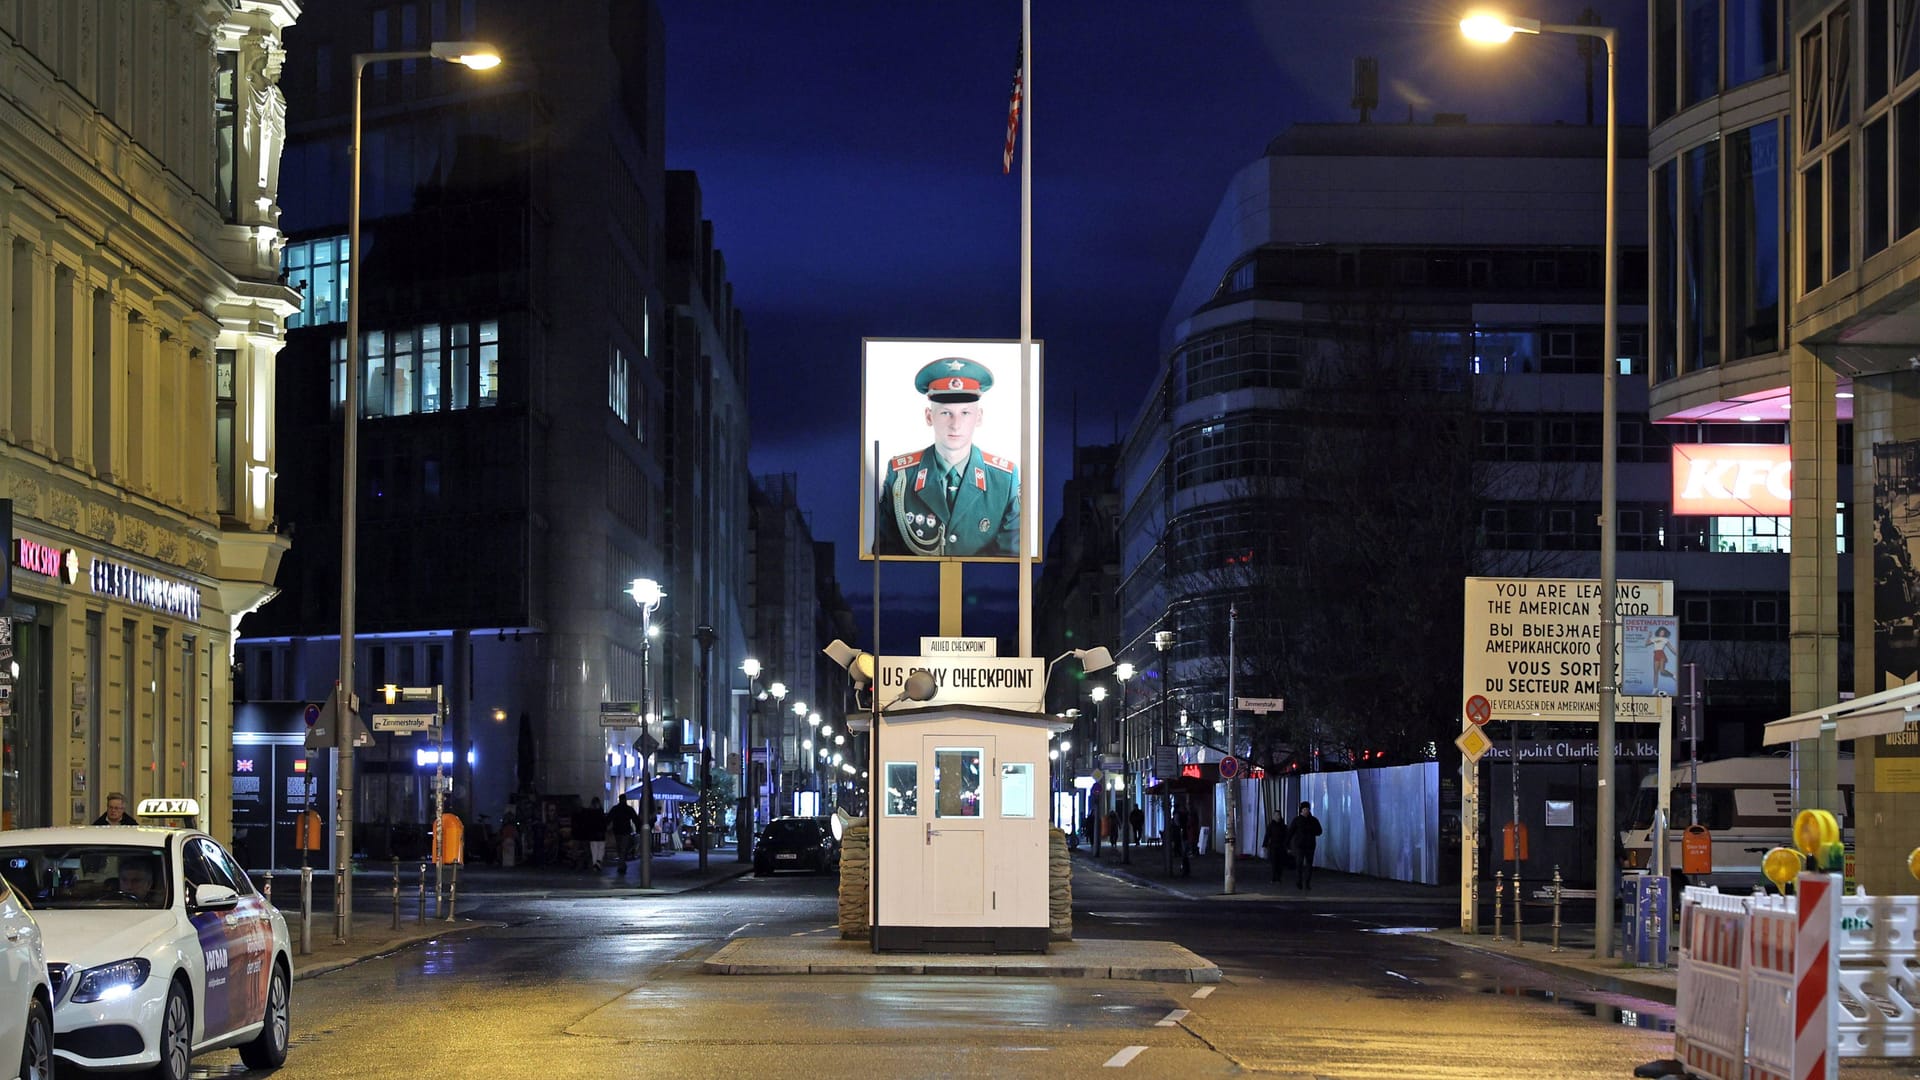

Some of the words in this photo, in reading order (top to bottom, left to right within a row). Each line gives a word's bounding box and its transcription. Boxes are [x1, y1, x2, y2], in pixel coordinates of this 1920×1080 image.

[1681, 459, 1791, 499] KFC
[21, 538, 41, 572] ROCK
[41, 545, 61, 577] SHOP
[1496, 583, 1527, 597] YOU
[1536, 584, 1566, 598] ARE
[1577, 585, 1640, 599] LEAING
[1488, 601, 1511, 614] THE
[1519, 601, 1589, 615] AMERICAN
[1599, 602, 1649, 616] CTOR
[1490, 623, 1512, 637] ВЫ
[1523, 624, 1600, 638] ВЫЕЗЖАЕ
[931, 641, 950, 652] ALLIED
[951, 641, 987, 652] CHECKPOINT
[1486, 640, 1590, 655] АМЕРИКАНСКОГО
[1508, 661, 1551, 675] VOUS
[1560, 661, 1619, 677] SORTZ
[953, 668, 1034, 688] CHECKPOINT
[1486, 678, 1503, 692] DU
[1509, 679, 1569, 693] SECTEUR
[1498, 700, 1539, 710] VERLASSEN
[1541, 701, 1555, 711] DEN
[1622, 702, 1649, 713] SEKTOR
[382, 718, 425, 728] Zimmerstraße
[1886, 732, 1918, 745] MUSEUM
[146, 801, 187, 812] TAXI
